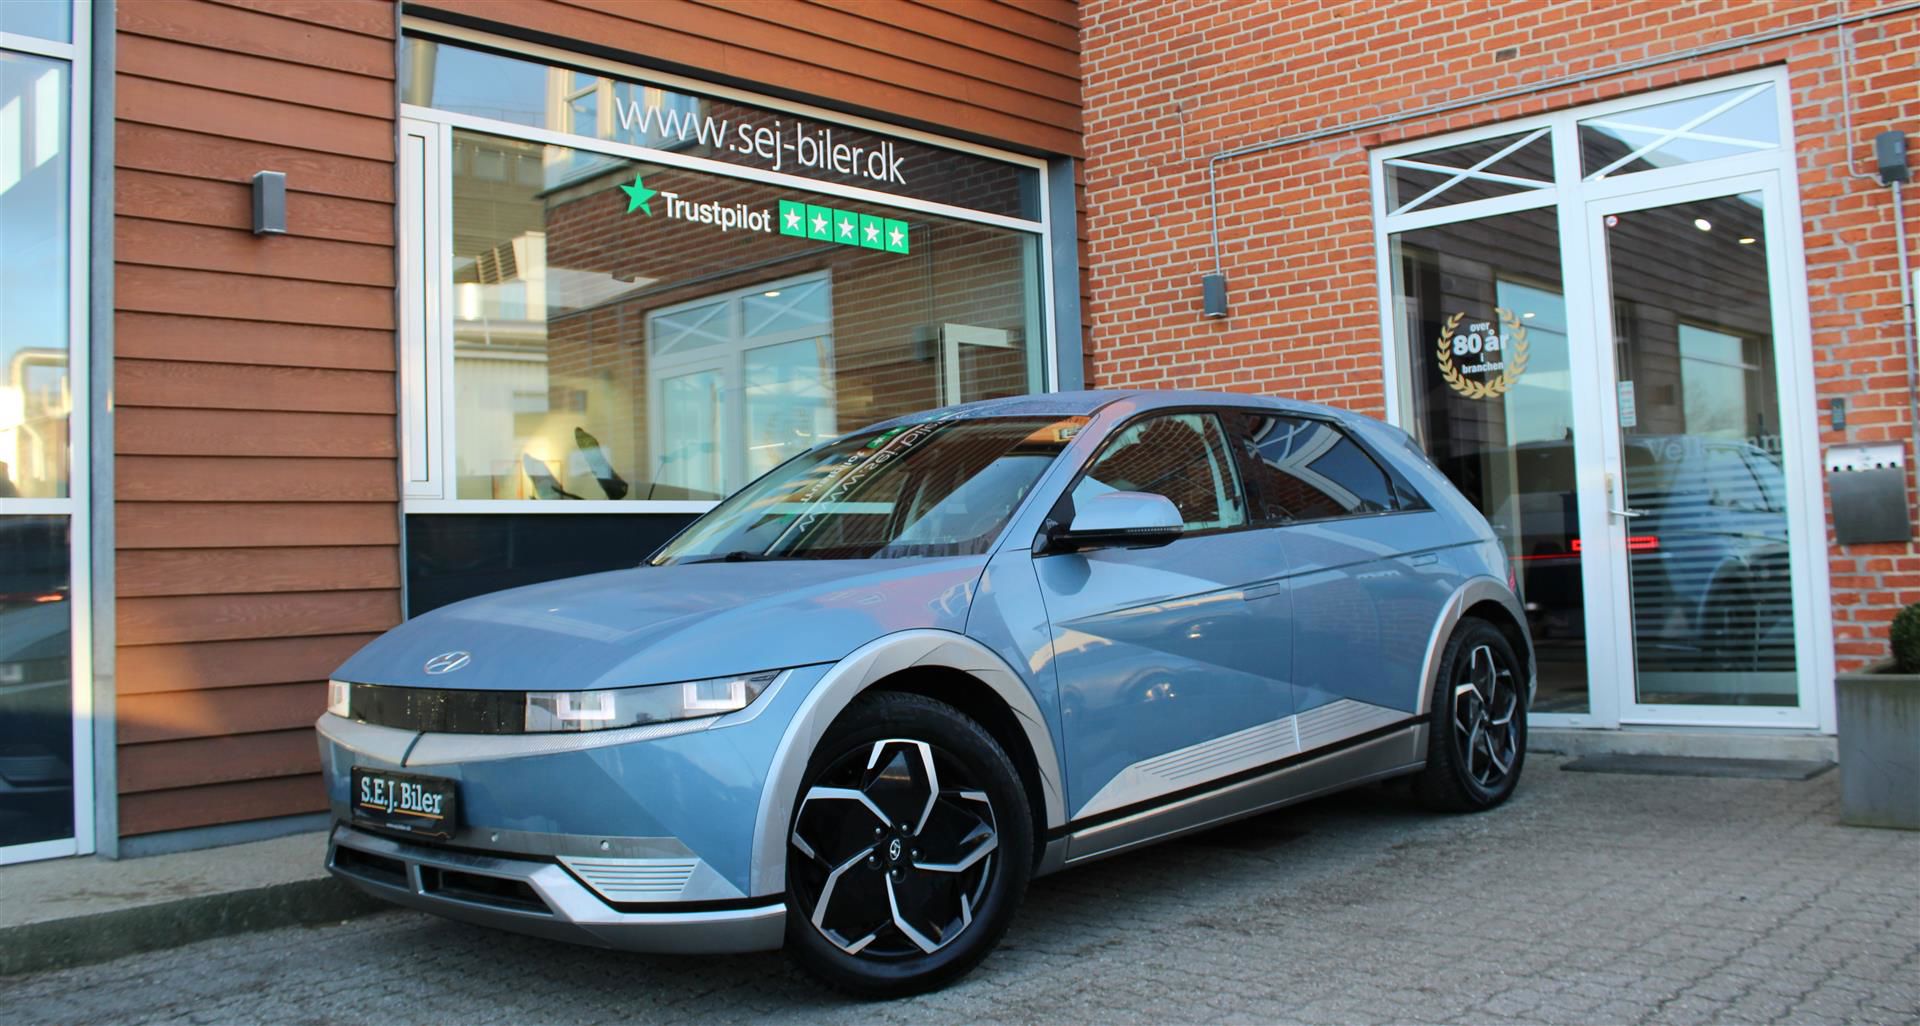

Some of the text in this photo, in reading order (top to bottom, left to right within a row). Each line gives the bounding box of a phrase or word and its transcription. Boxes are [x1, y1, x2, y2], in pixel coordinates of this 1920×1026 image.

[615, 96, 907, 186] www.sej-biler.dk
[661, 191, 772, 233] Trustpilot
[1453, 329, 1509, 356] 80 år
[1470, 322, 1490, 332] over
[1462, 361, 1504, 374] branchen
[361, 776, 443, 814] S.E.J. Biler
